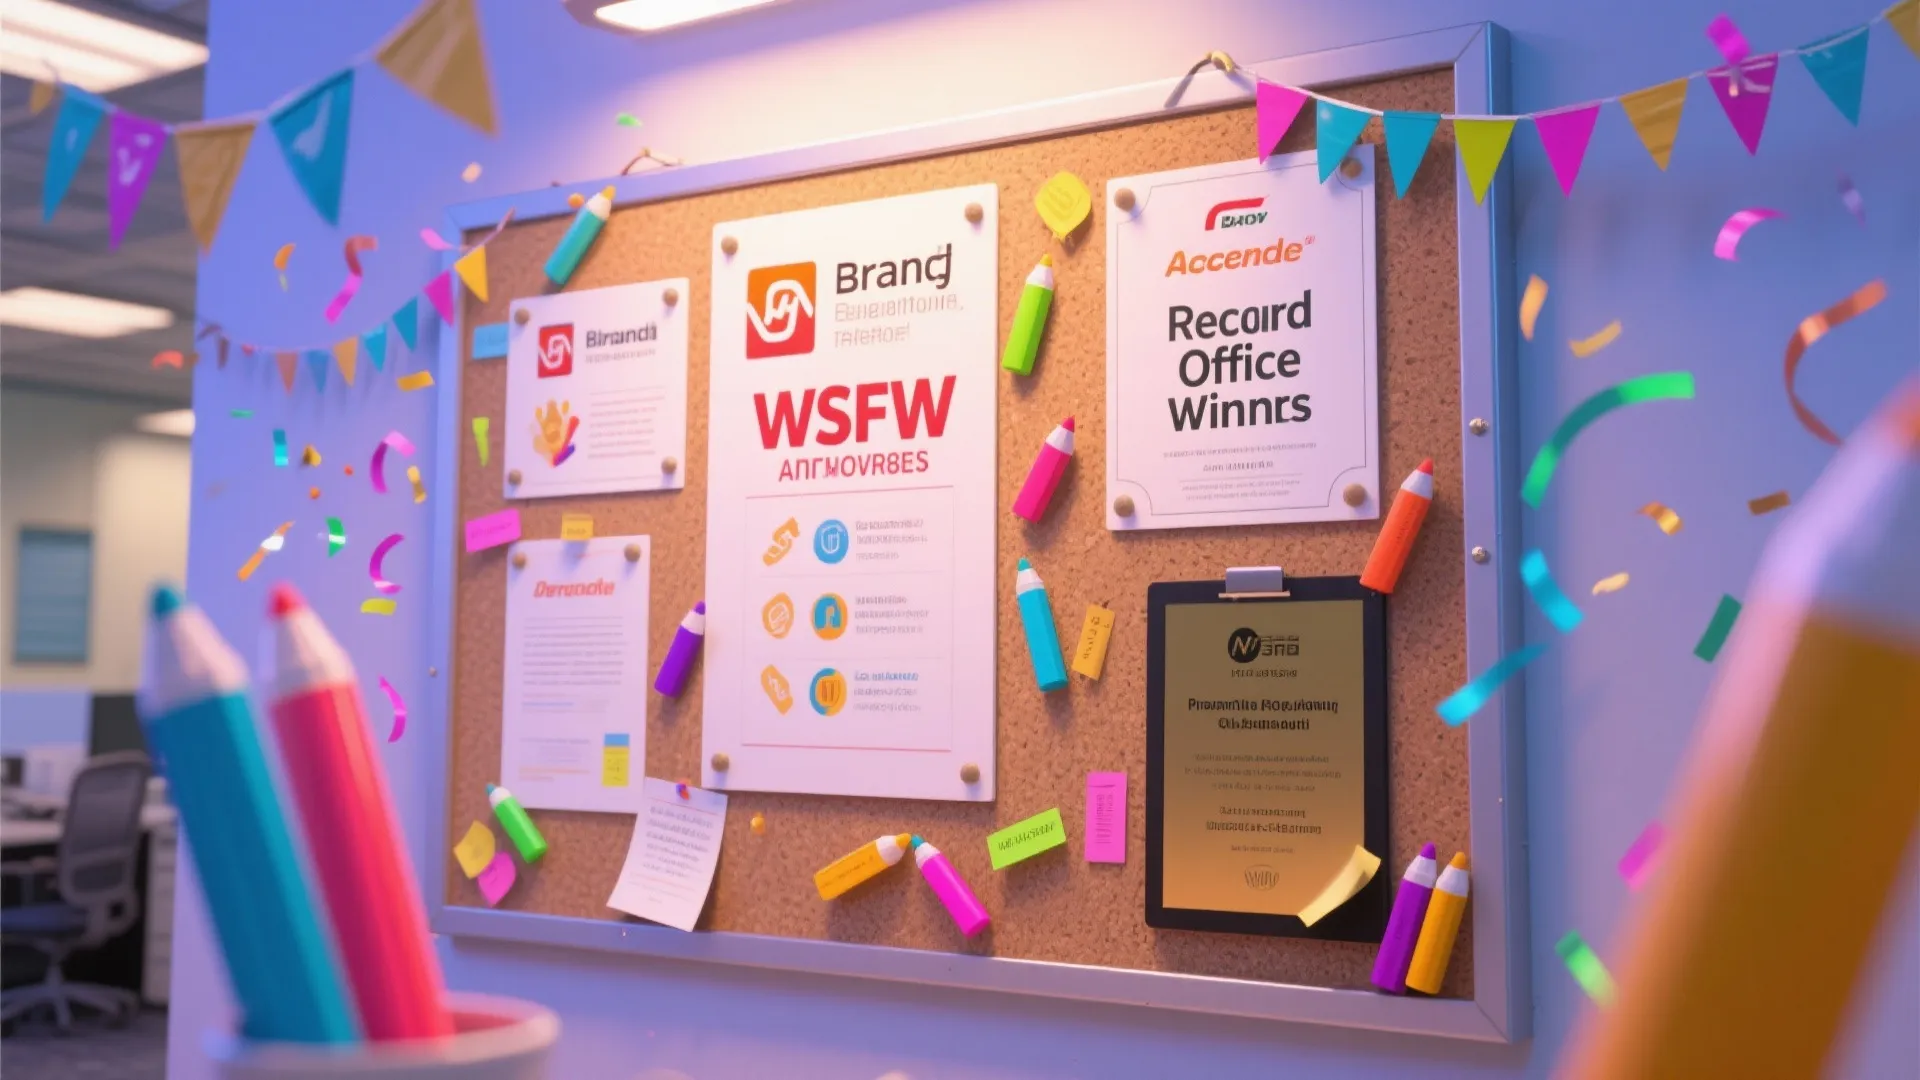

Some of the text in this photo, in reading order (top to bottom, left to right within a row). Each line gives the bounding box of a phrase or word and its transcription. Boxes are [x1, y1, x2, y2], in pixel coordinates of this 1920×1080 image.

[1165, 237, 1303, 277] Accende
[1178, 343, 1301, 388] Office
[753, 375, 957, 450] WSFW
